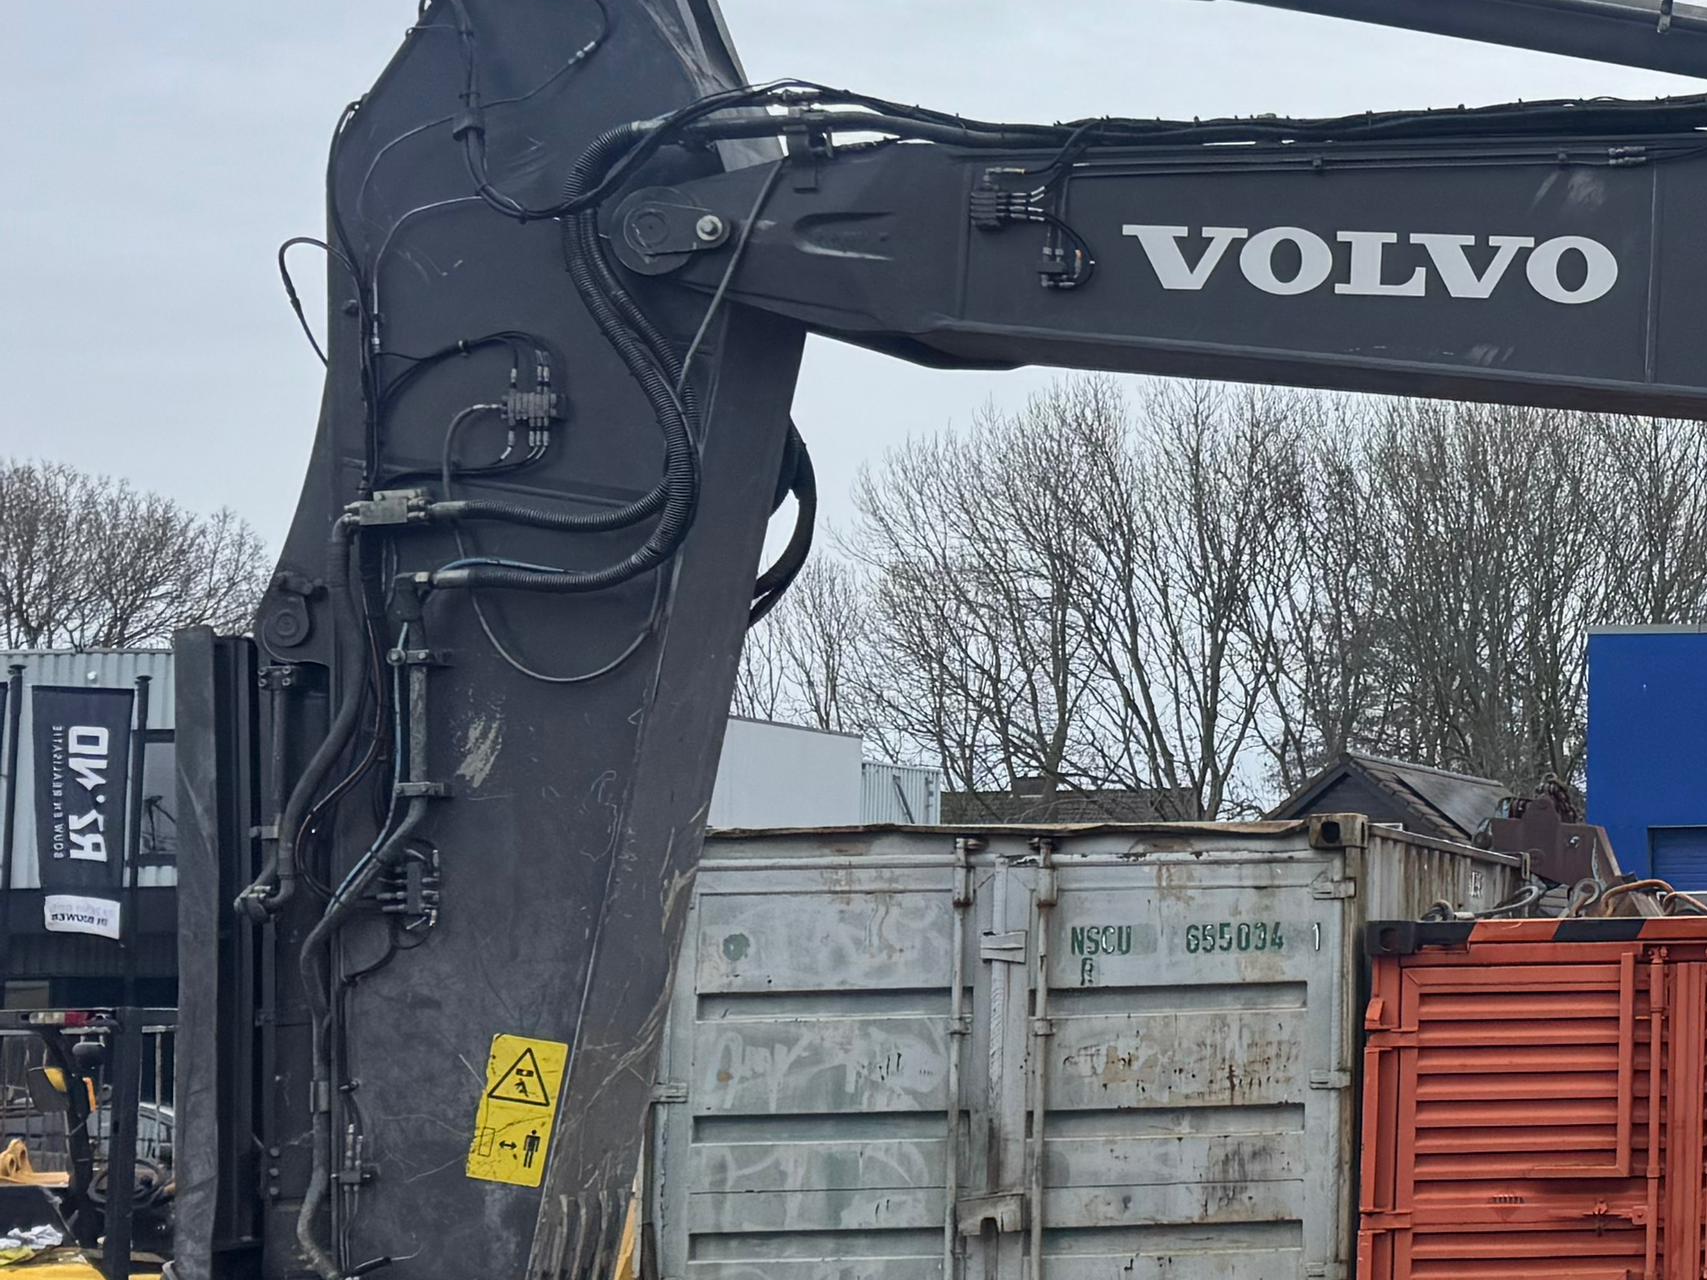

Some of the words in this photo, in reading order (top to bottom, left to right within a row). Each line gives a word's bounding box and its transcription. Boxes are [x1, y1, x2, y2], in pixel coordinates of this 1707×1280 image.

[1122, 224, 1618, 304] VOLVO
[1071, 925, 1132, 956] NSCU
[1312, 922, 1321, 952] 1
